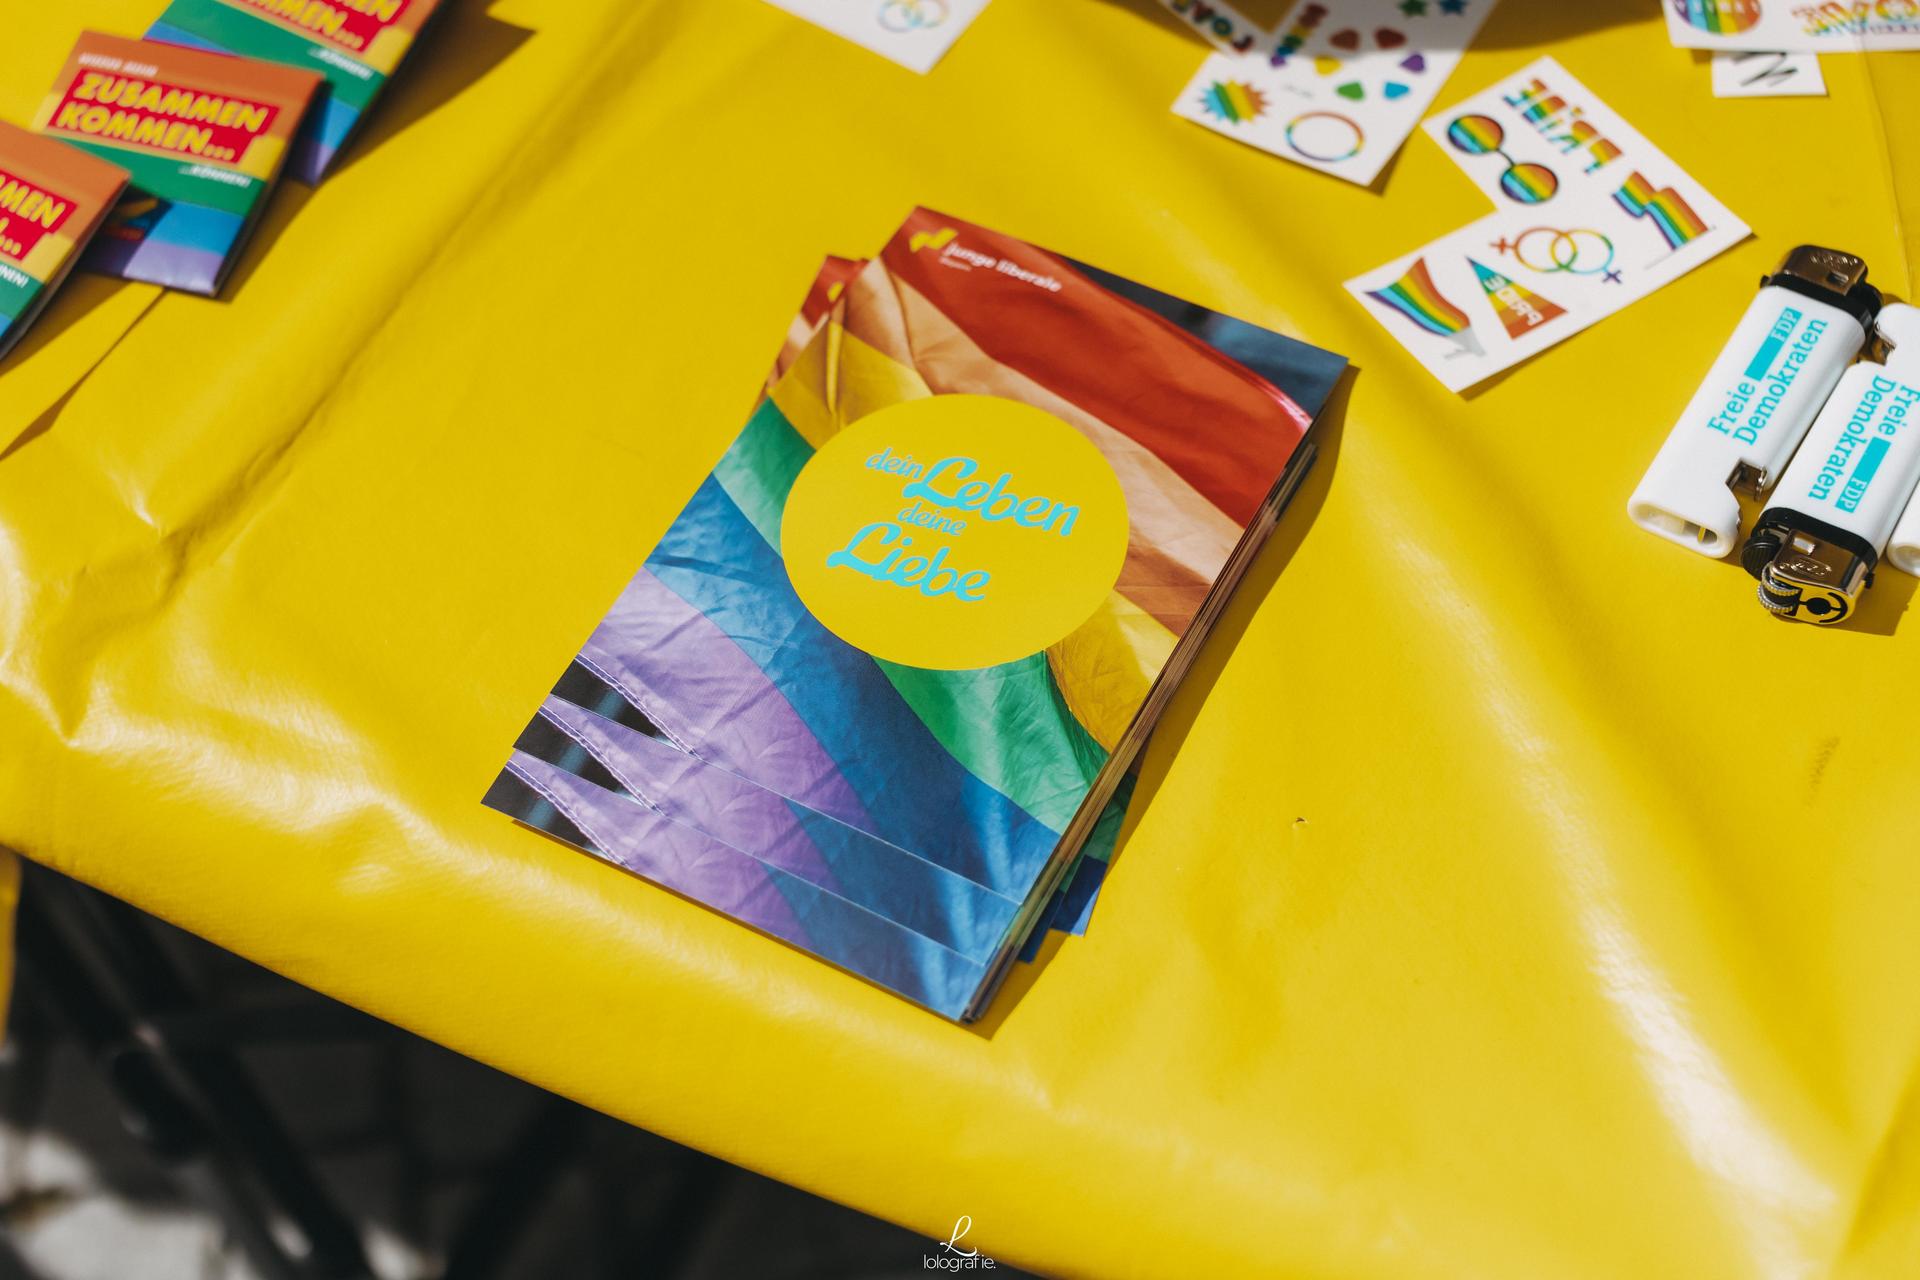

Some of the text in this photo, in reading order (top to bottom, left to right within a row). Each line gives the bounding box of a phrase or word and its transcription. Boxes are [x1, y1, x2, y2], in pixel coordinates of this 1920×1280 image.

[56, 101, 236, 162] KOMMEN...
[72, 72, 269, 133] ZUSAMMEN
[942, 241, 997, 268] junge
[996, 259, 1063, 292] liberale
[1706, 308, 1801, 436] Freie FDP
[1732, 320, 1829, 447] Demokraten
[1807, 374, 1897, 501] Demokraten
[1838, 384, 1920, 513] Freie FDP
[864, 446, 1080, 536] dein Leben
[897, 501, 967, 536] deine
[825, 522, 991, 602] Liebe
